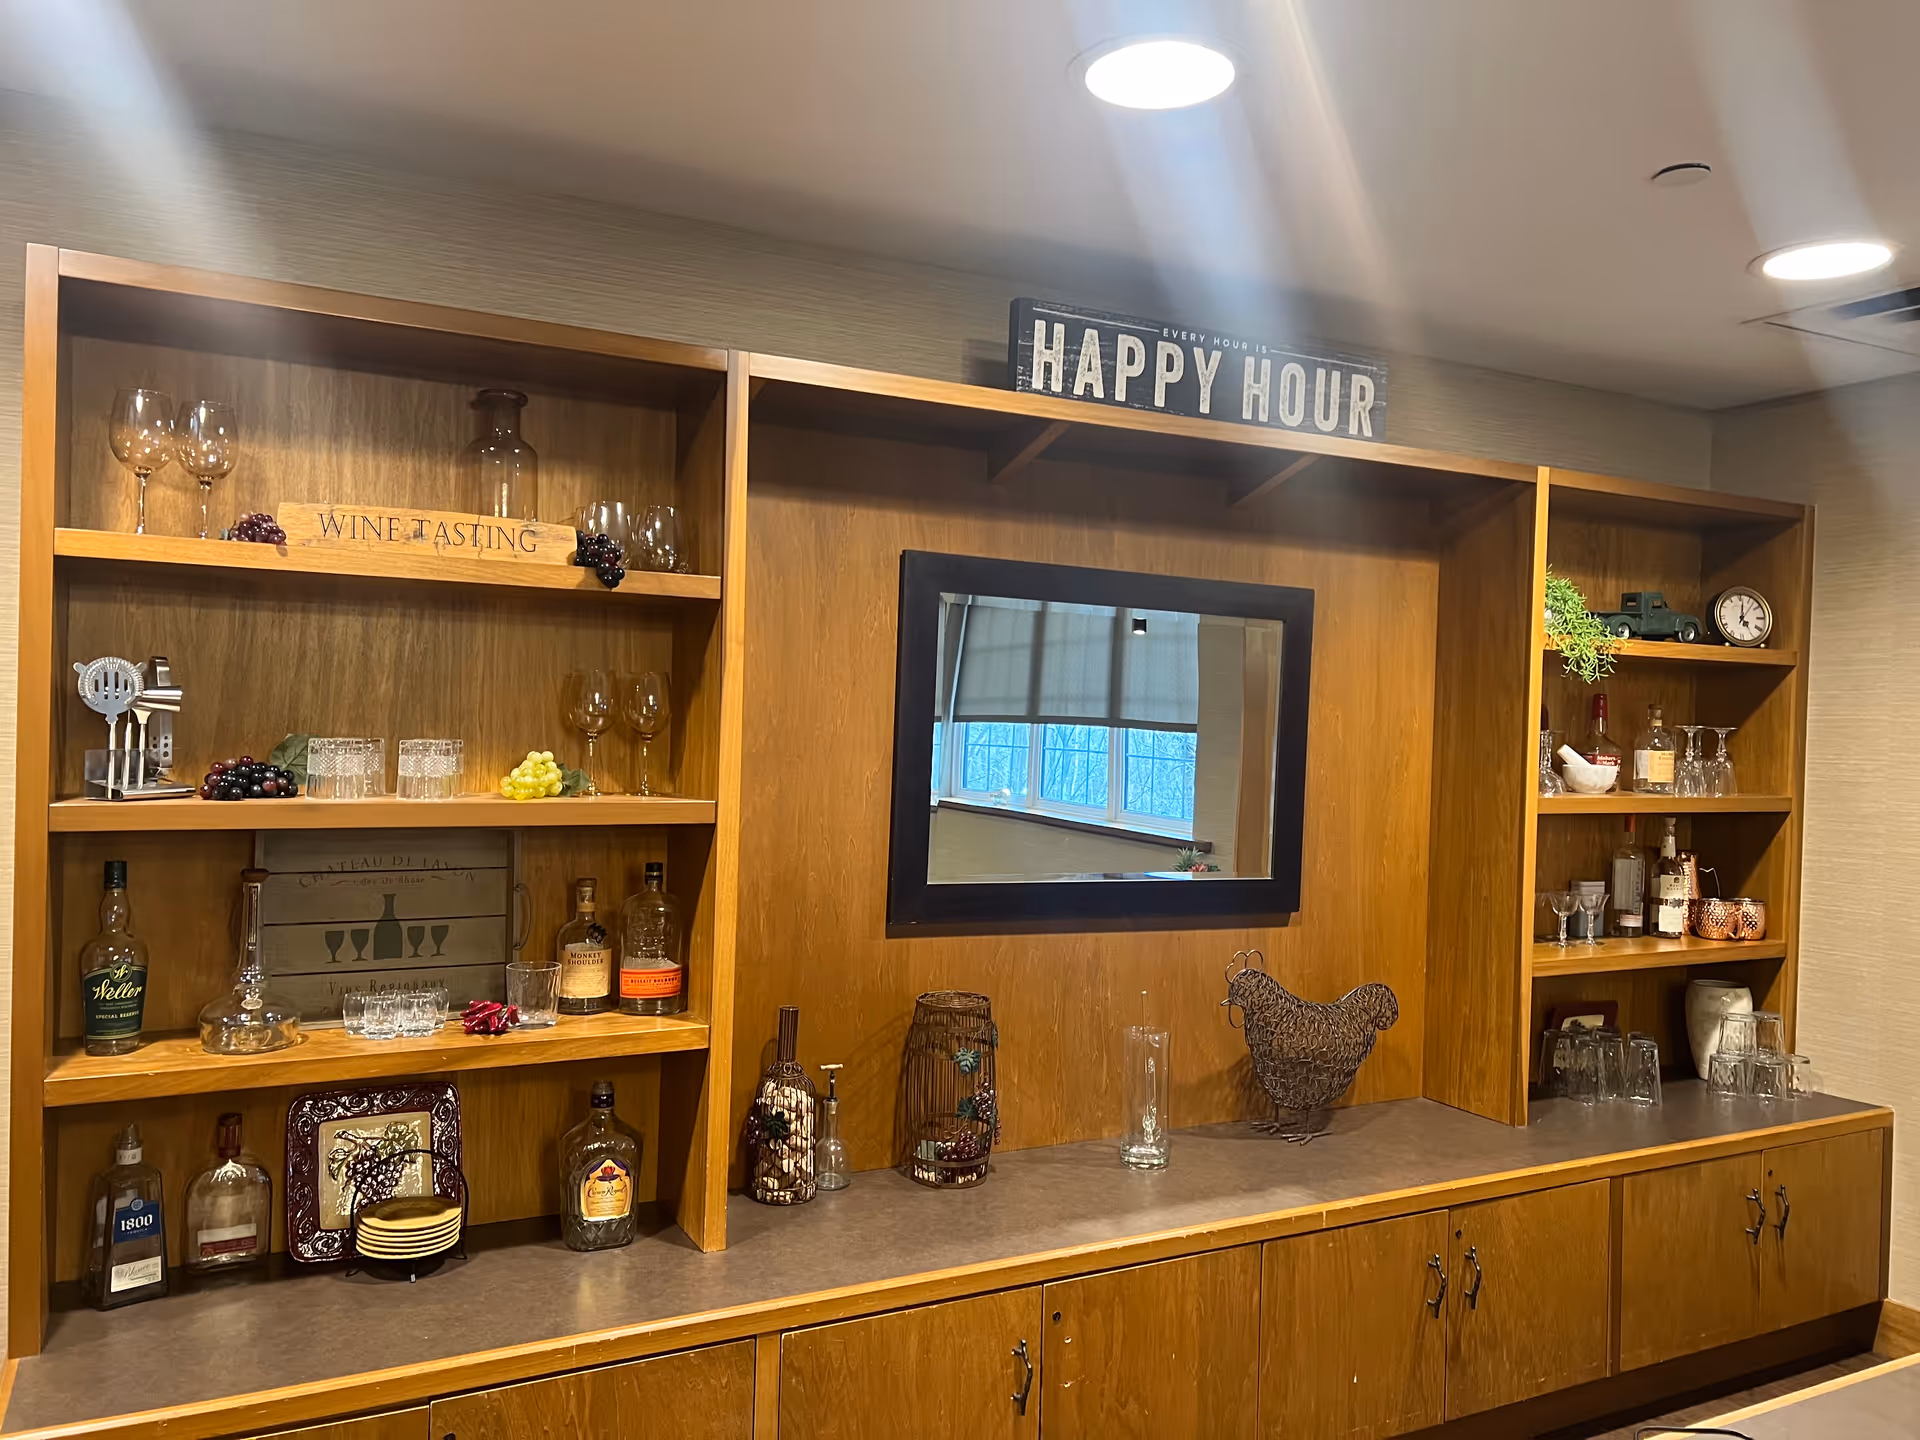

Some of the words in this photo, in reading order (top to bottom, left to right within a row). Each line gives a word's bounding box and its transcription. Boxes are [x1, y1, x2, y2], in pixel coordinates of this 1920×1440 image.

[1163, 327, 1206, 343] EVERY
[1213, 336, 1248, 351] HOUR
[1255, 343, 1267, 354] IS
[1031, 319, 1222, 414] HAPPY
[1242, 355, 1375, 437] HOUR
[317, 512, 401, 542] WINE
[411, 518, 538, 553] TASTING
[92, 979, 143, 1000] Weller
[120, 1213, 153, 1231] 1800
